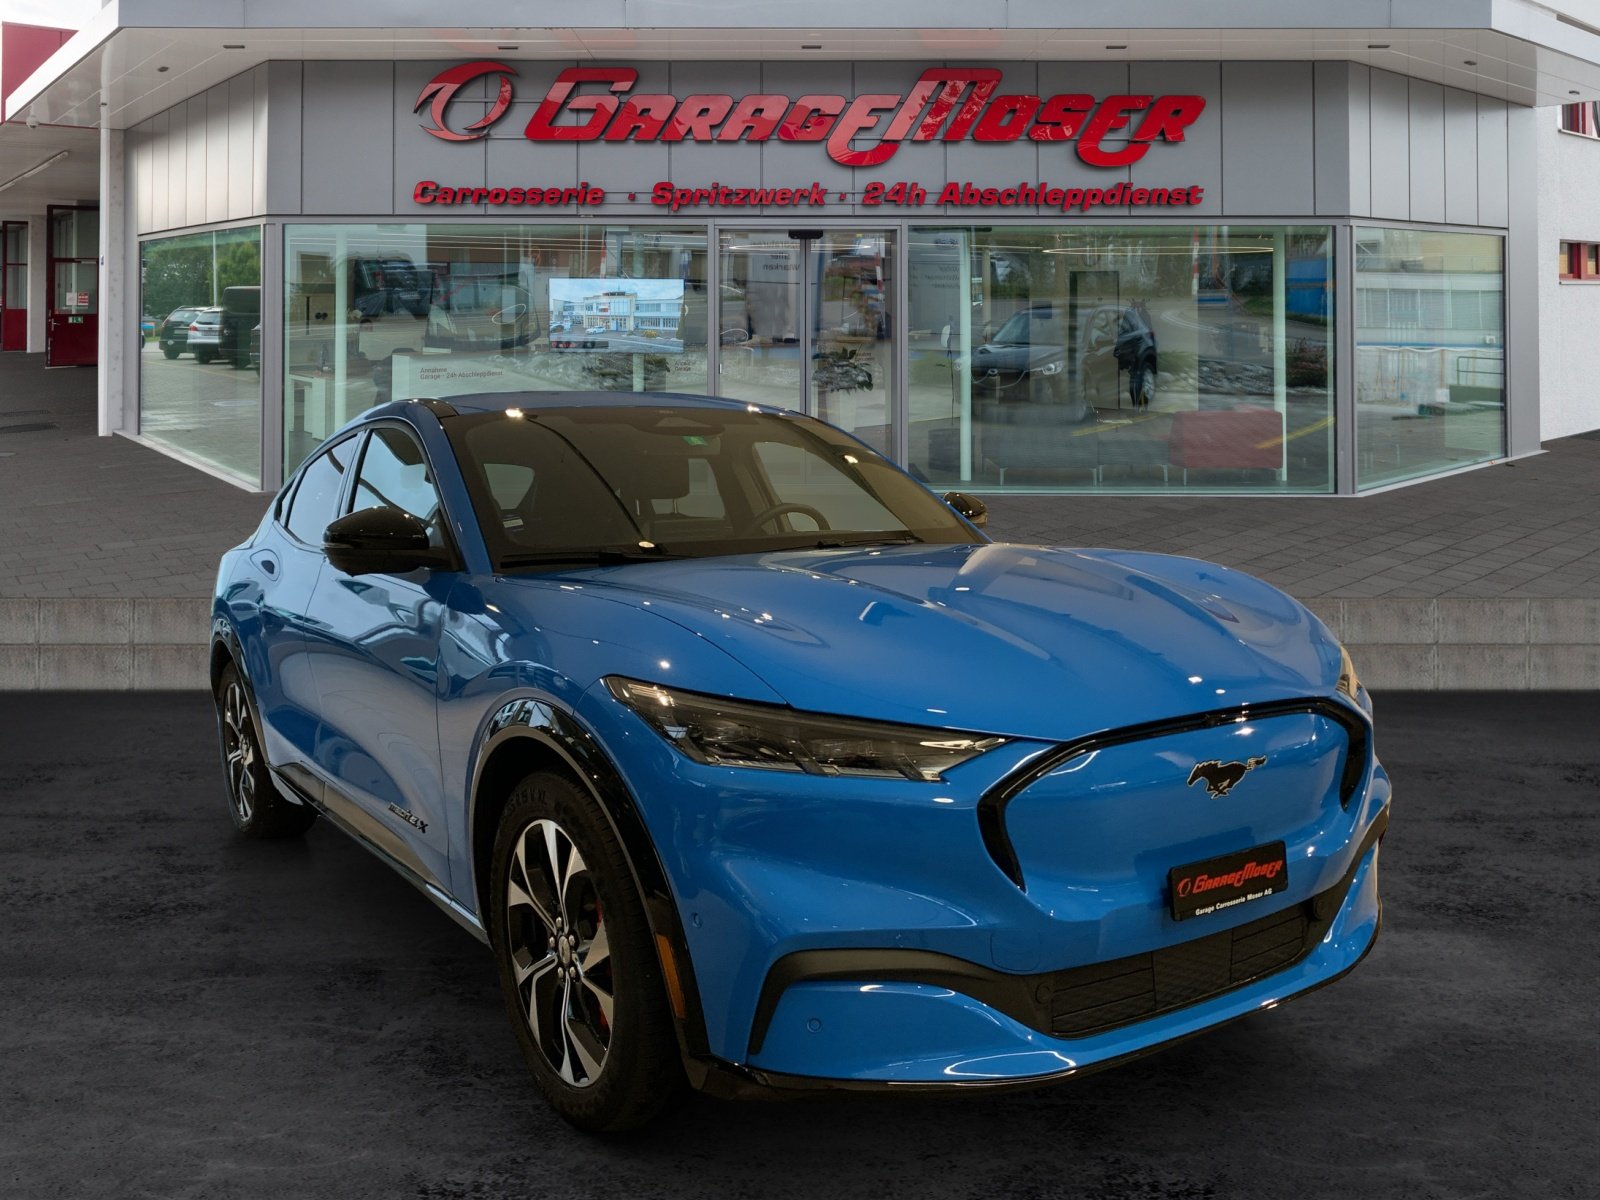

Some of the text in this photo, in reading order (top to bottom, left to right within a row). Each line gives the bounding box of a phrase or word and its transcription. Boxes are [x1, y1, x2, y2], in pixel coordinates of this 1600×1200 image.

[413, 181, 1205, 212] Carrosserie Spritzwerk 24h Abschleppdienst
[1195, 887, 1273, 916] Garage Carrosserie Moser AG
